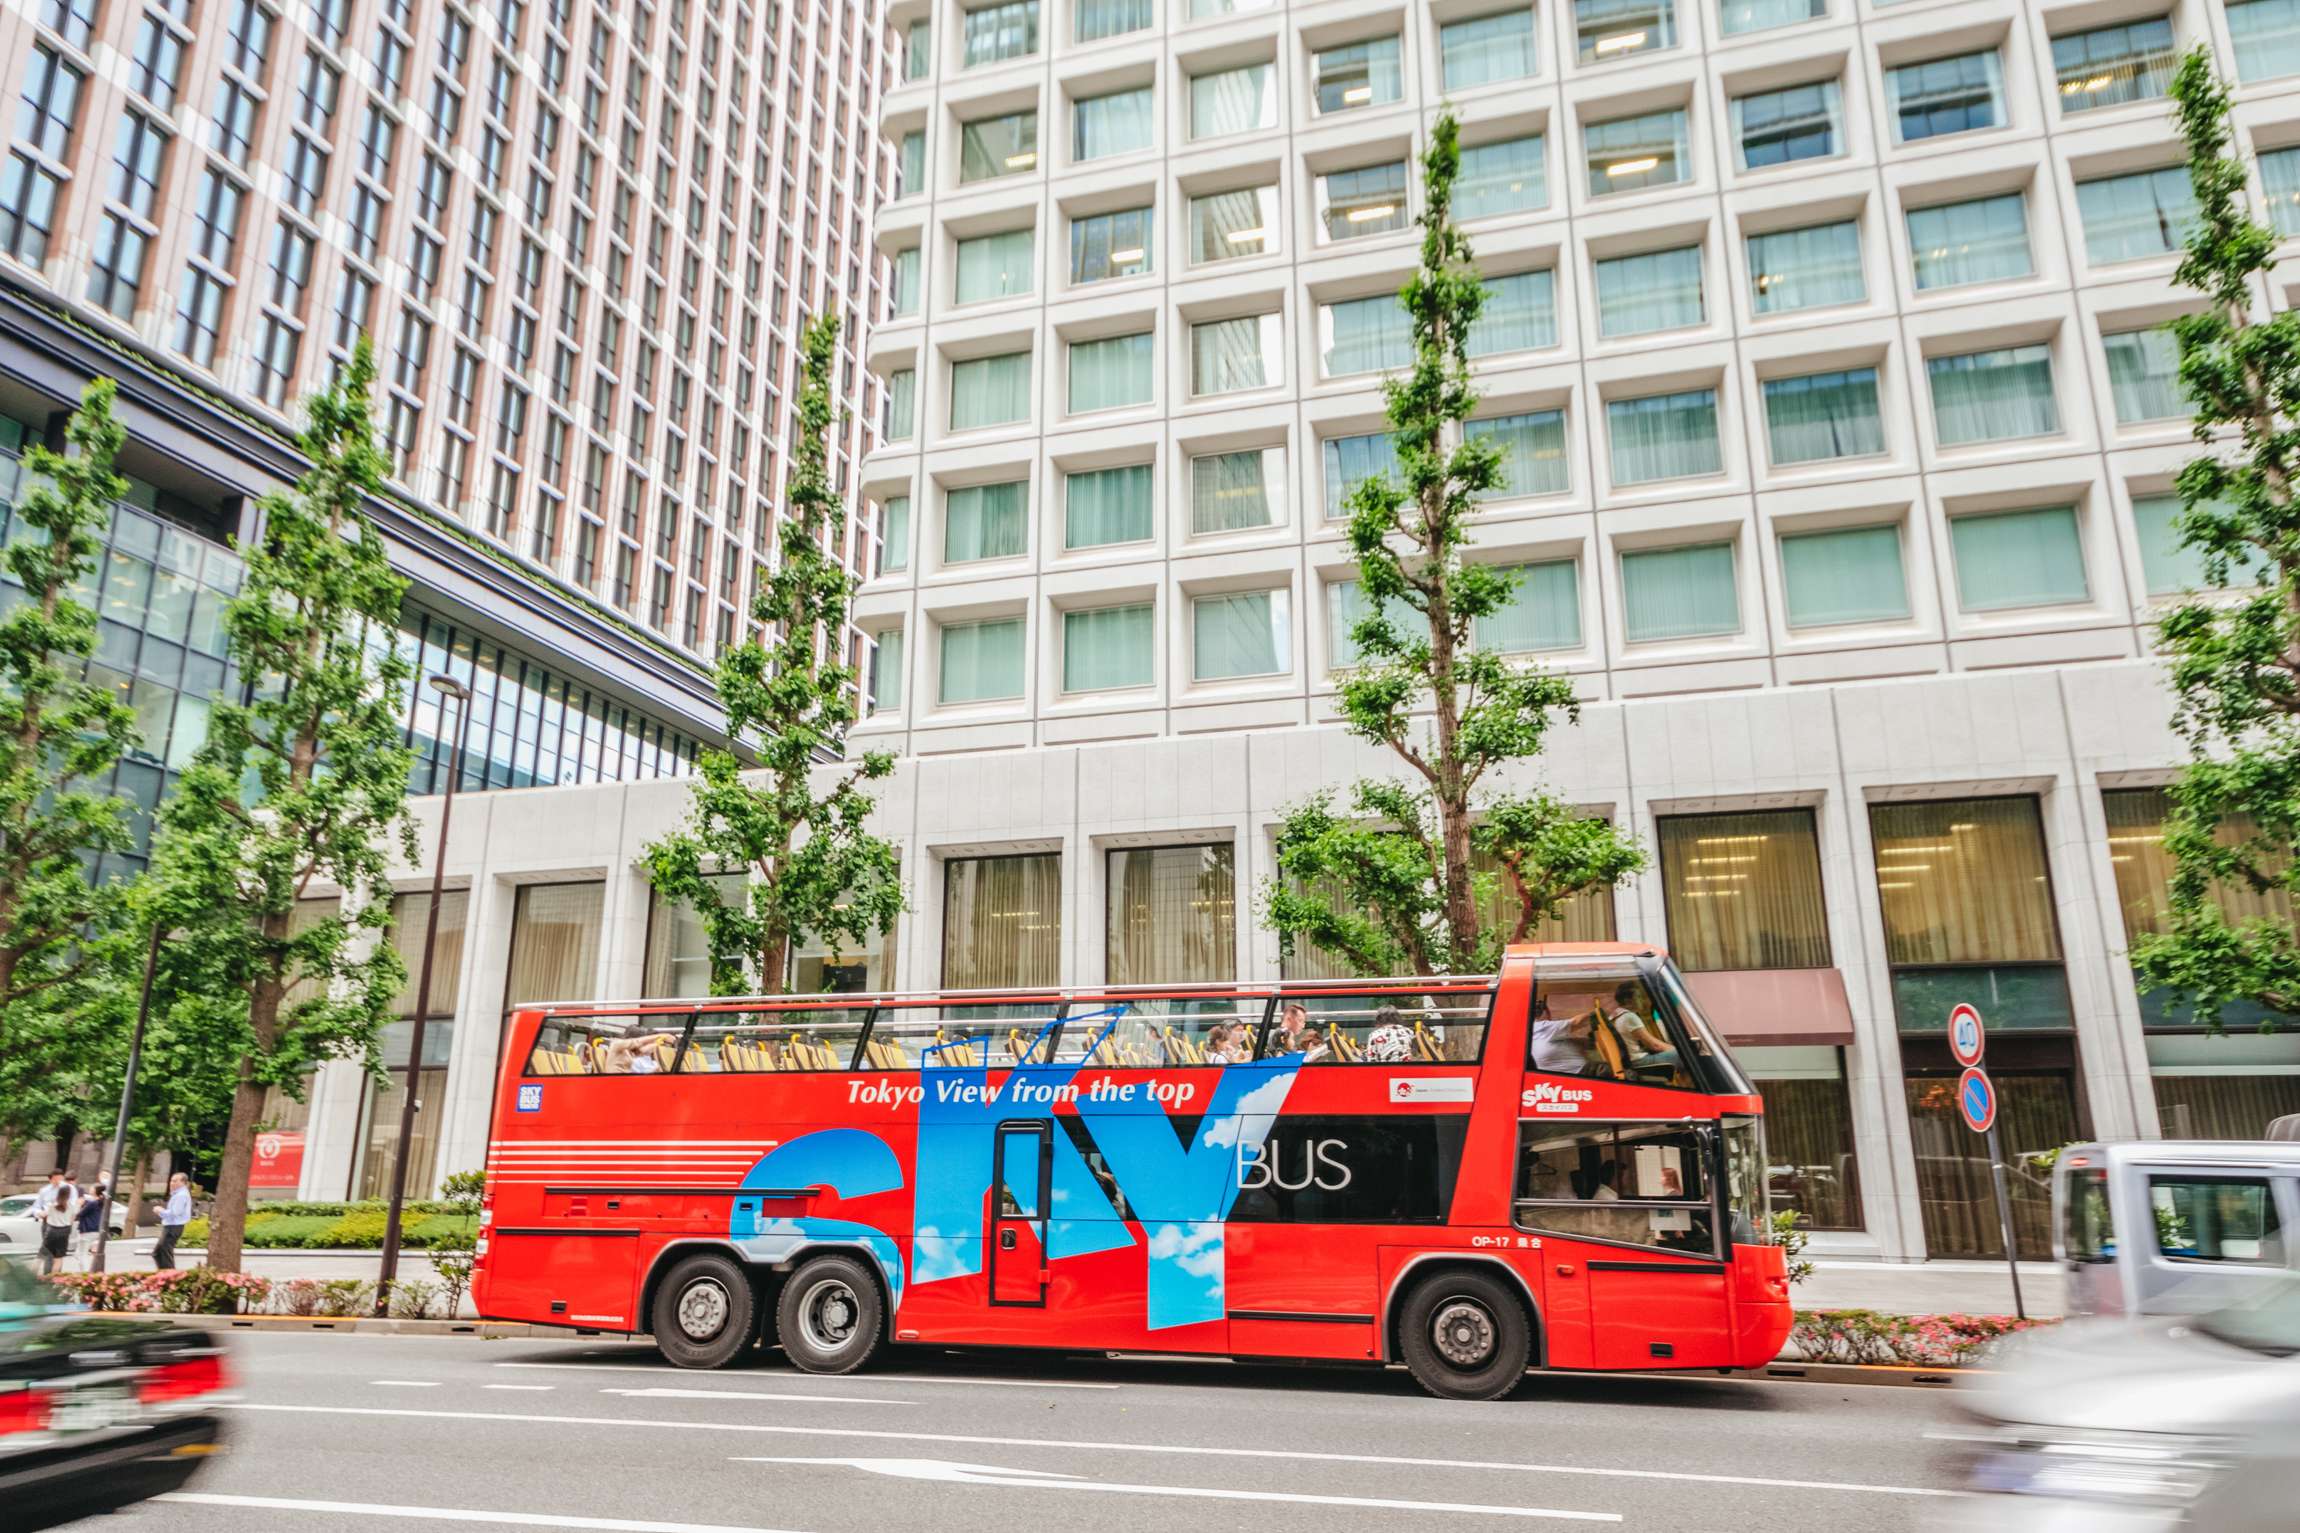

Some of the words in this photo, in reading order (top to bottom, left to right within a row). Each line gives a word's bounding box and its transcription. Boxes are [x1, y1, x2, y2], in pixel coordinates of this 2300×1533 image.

[1958, 1021, 1976, 1047] 40
[520, 1086, 542, 1095] SKY
[848, 1078, 925, 1111] Tokyo
[936, 1078, 1003, 1103] View
[1012, 1077, 1079, 1103] from
[1090, 1076, 1136, 1102] the
[1146, 1078, 1195, 1109] top
[1522, 1082, 1563, 1107] SKY
[1562, 1090, 1593, 1101] BUS
[730, 1006, 1307, 1331] SKY
[1237, 1139, 1351, 1190] BUS
[1472, 1236, 1510, 1247] OP-17
